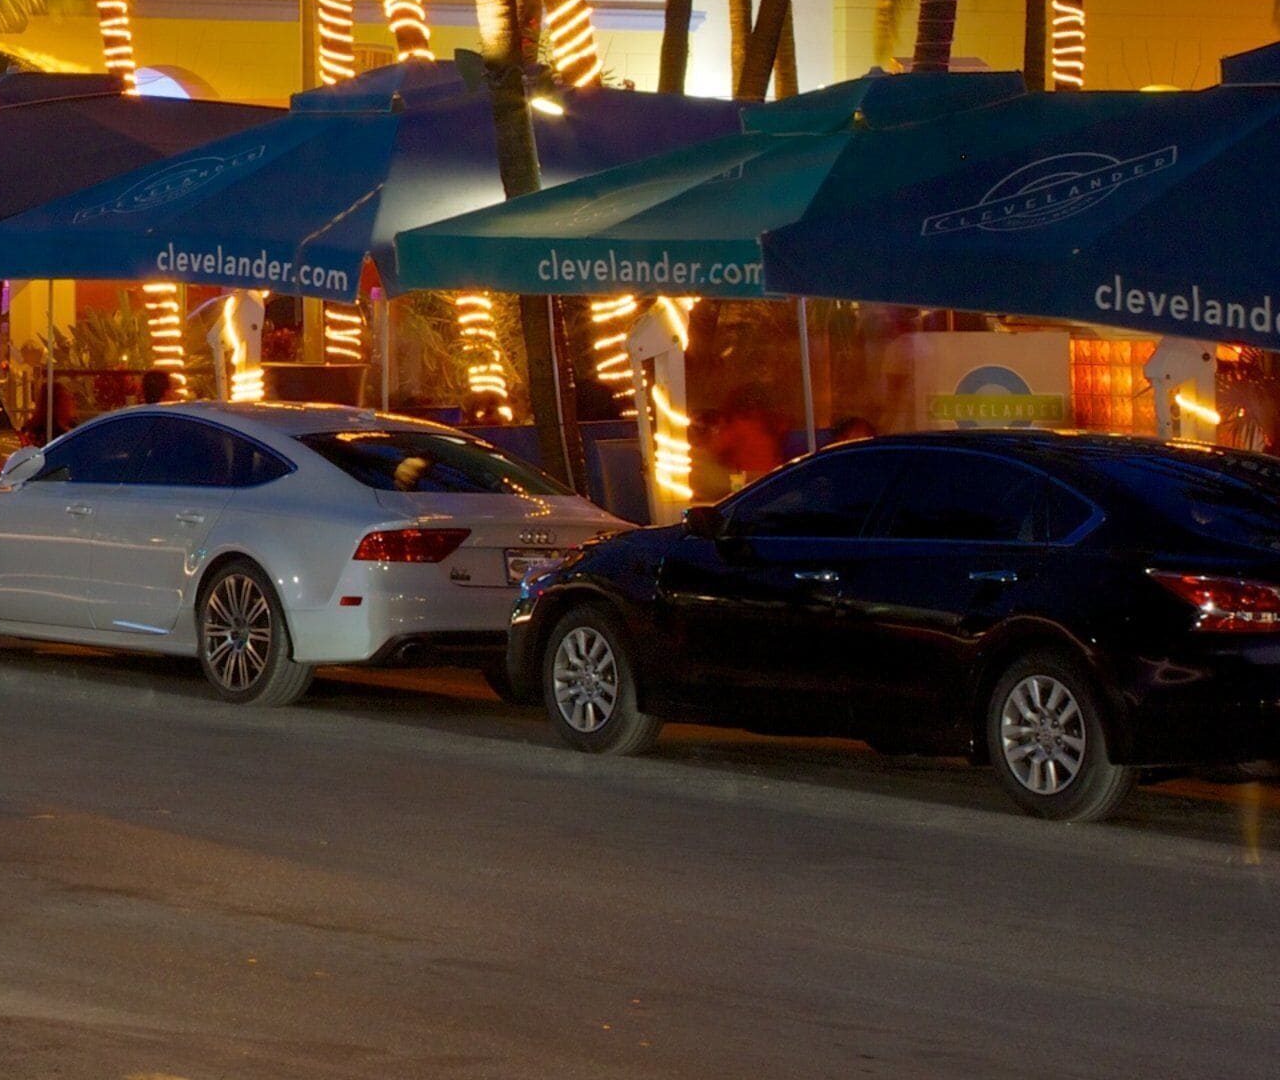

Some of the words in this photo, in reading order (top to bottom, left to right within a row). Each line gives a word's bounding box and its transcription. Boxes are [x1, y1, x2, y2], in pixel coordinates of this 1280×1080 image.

[934, 157, 1166, 230] CLEVELANDER
[156, 242, 349, 291] clevelander.com
[1095, 274, 1280, 334] cleveland
[929, 399, 1058, 418] CLEVELANDER
